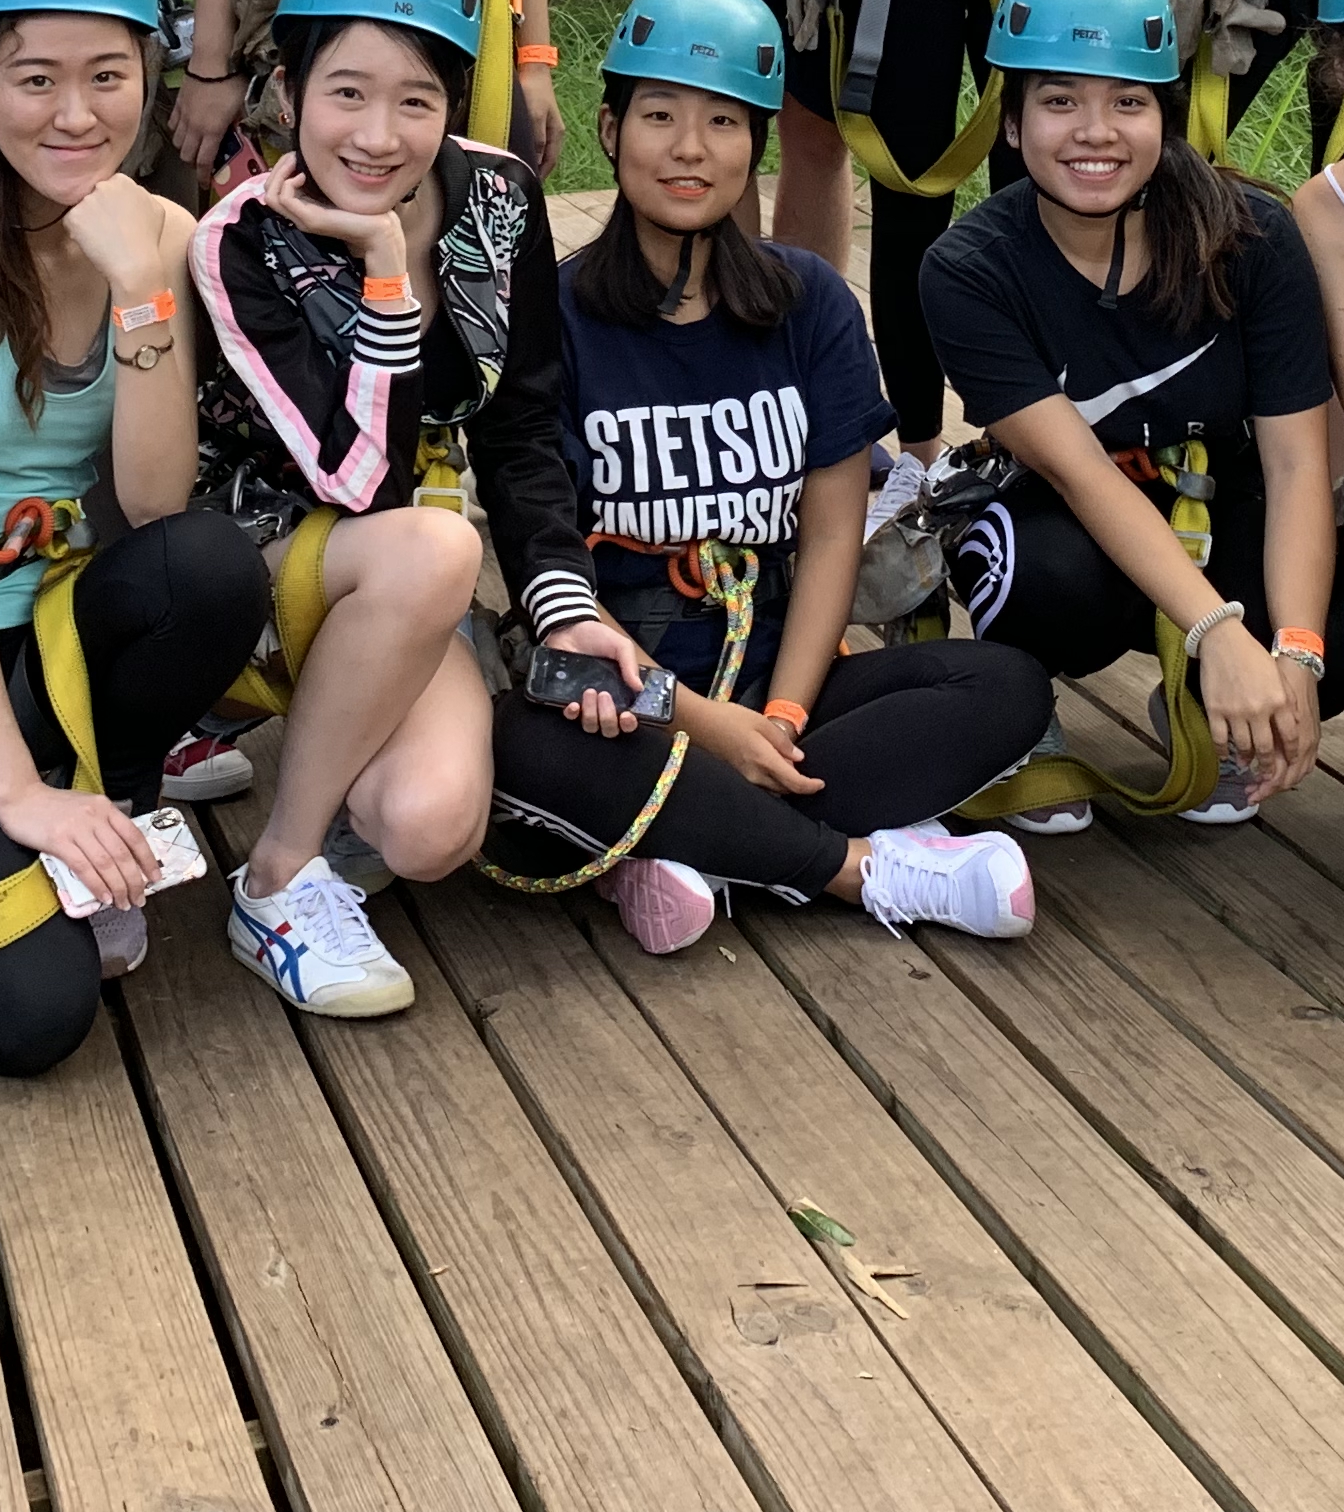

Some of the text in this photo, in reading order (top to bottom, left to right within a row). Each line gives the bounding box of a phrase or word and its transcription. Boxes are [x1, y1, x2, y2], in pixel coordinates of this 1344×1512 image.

[394, 1, 414, 16] N8
[1072, 28, 1103, 42] PETZL
[689, 43, 719, 58] PETZL
[584, 386, 809, 495] STETSON
